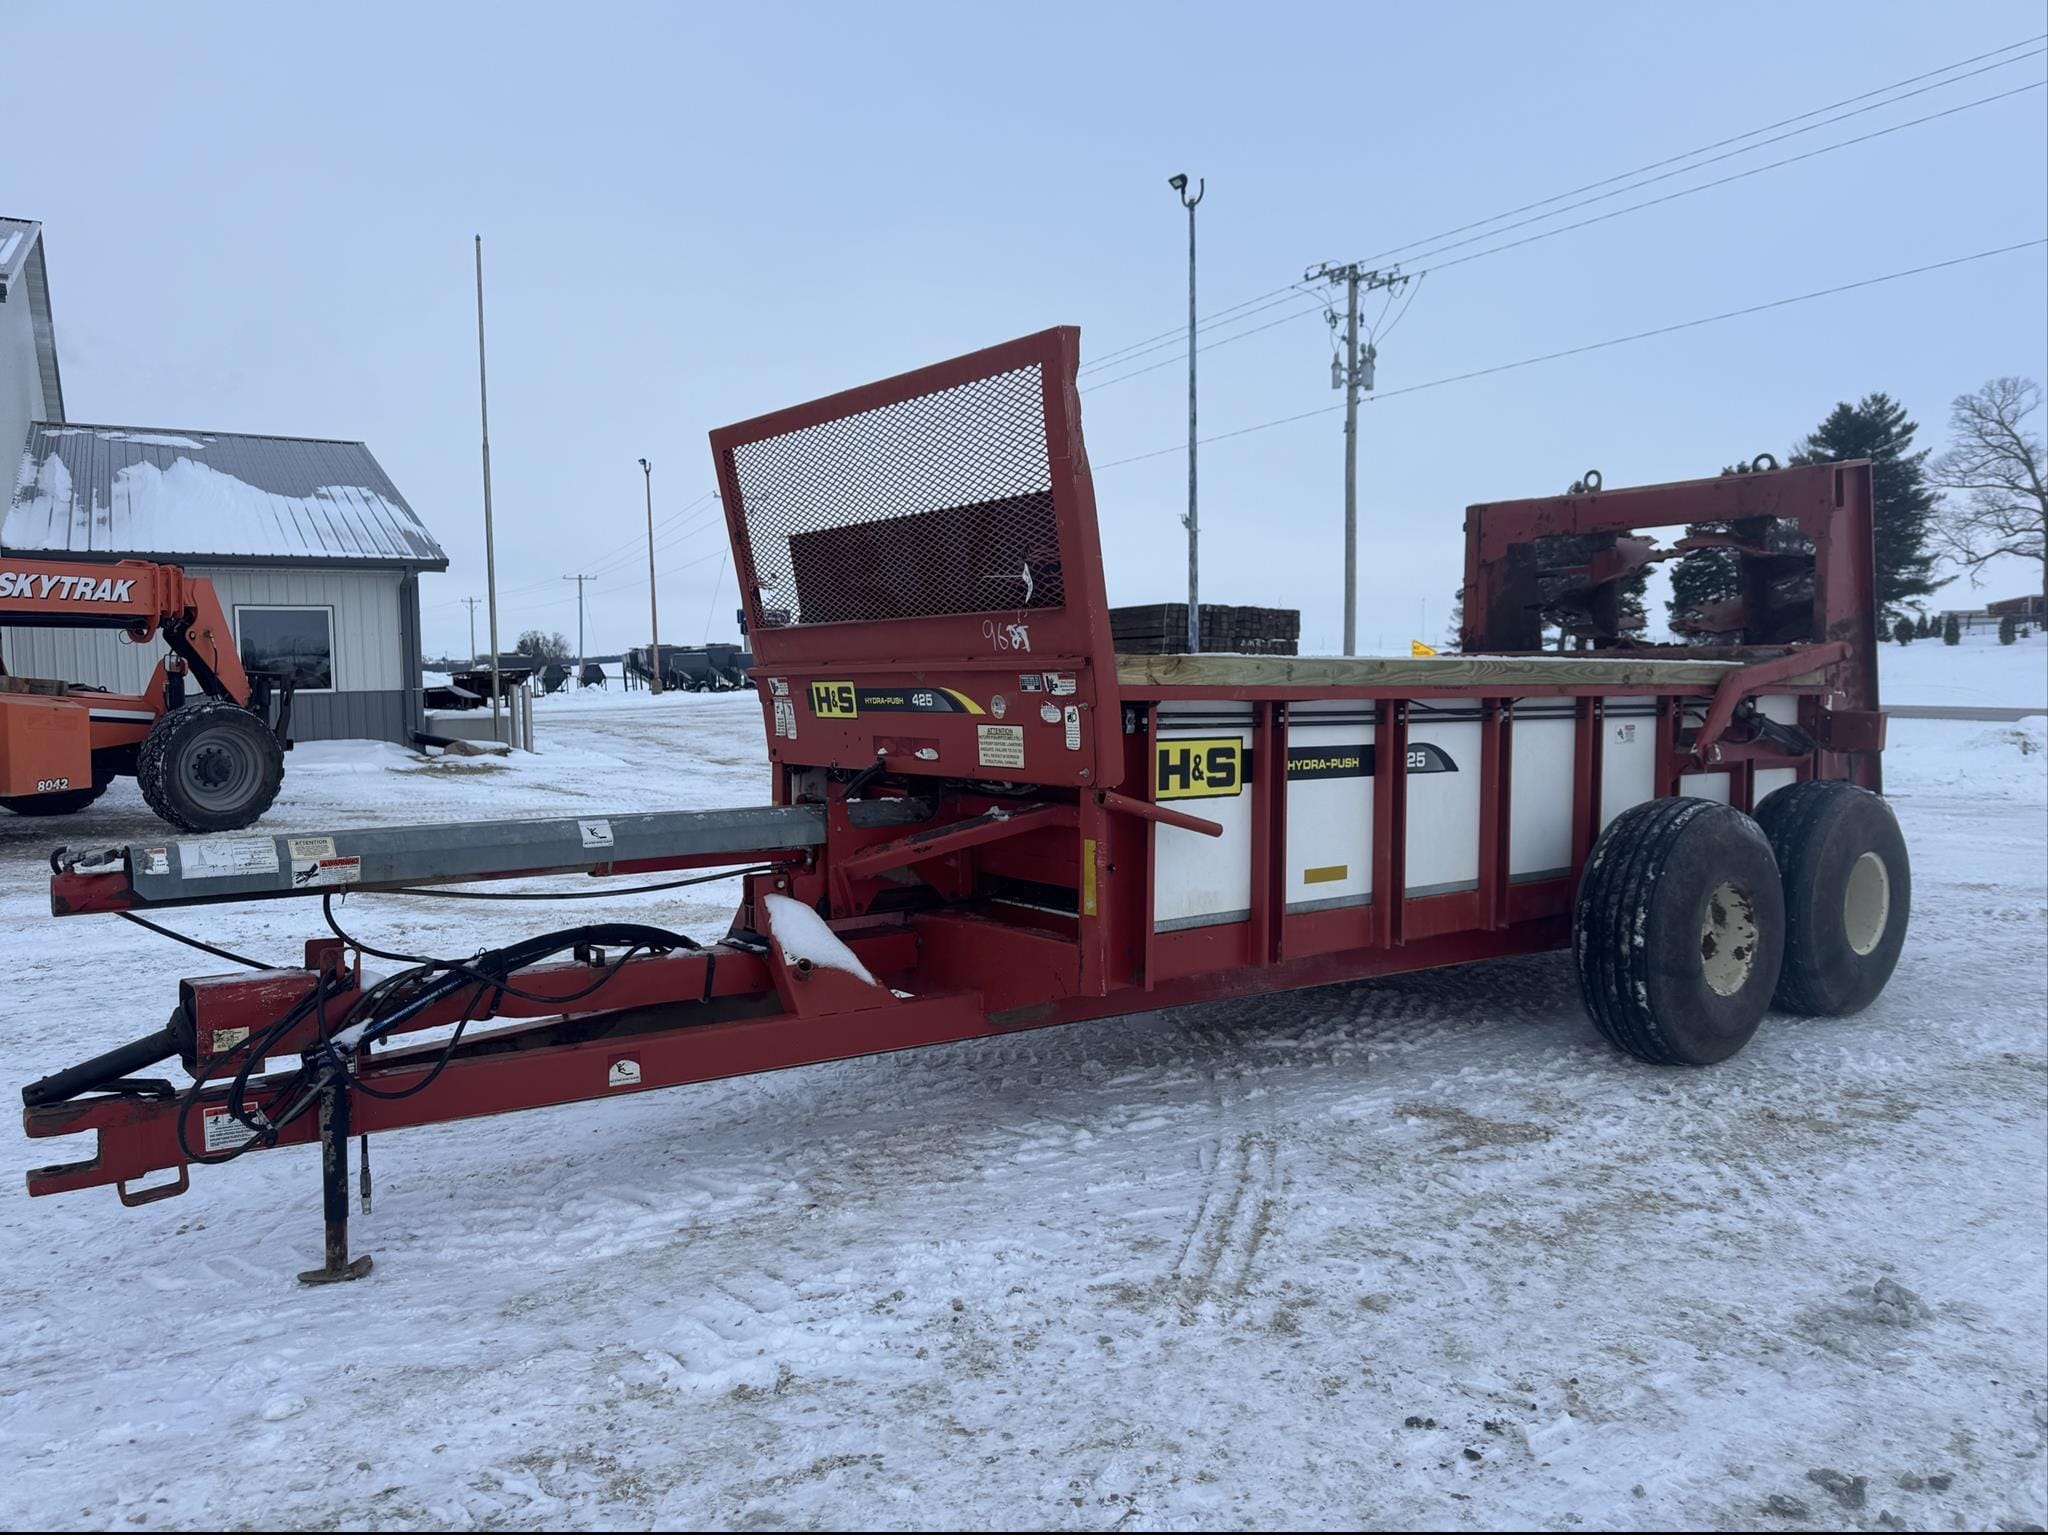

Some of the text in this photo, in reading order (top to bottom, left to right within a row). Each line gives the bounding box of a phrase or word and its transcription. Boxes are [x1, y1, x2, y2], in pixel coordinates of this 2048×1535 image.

[0, 572, 136, 602] SKYTRAK
[816, 685, 933, 713] H&S HYDRA-PUSH 425
[1158, 747, 1426, 791] H&S HYDRA-PUSH 25
[37, 778, 69, 792] 8042
